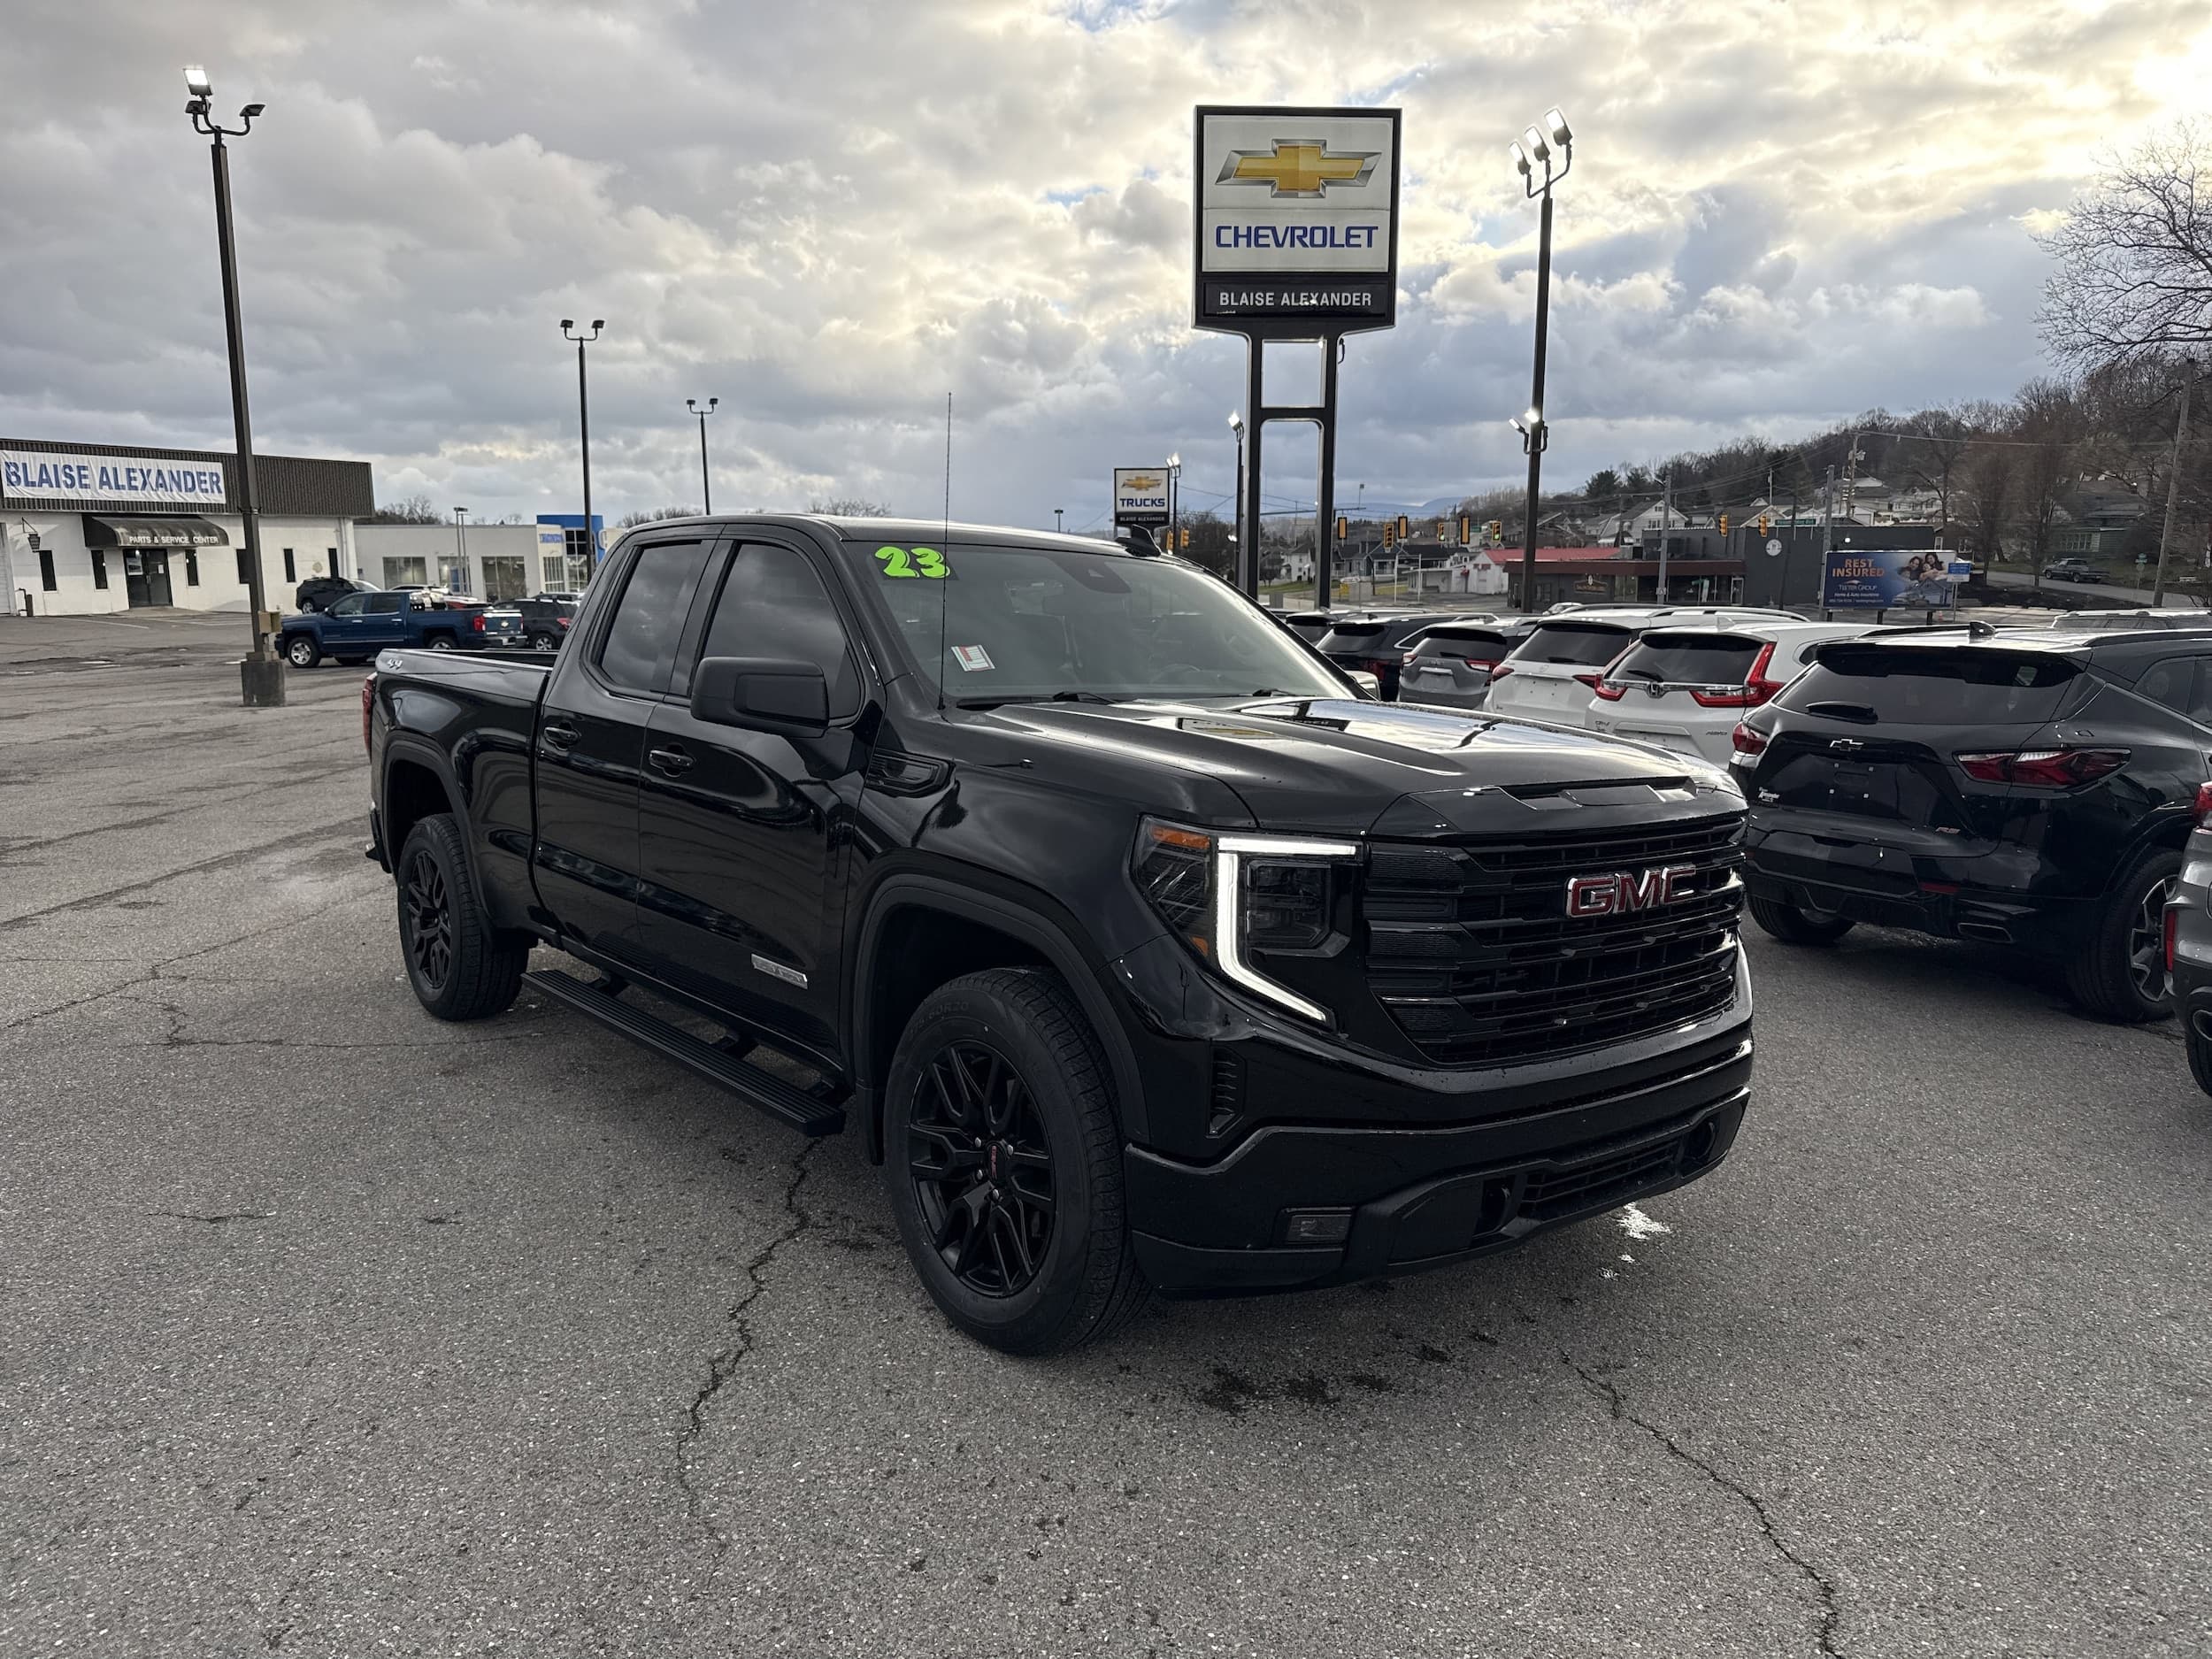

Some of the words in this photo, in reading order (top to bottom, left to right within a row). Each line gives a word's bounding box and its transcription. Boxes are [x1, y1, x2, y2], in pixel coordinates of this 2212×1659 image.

[1216, 226, 1379, 248] CHEVROLET
[1219, 292, 1275, 306] BLAISE
[1280, 292, 1371, 307] ALEXANDER
[4, 461, 91, 489] BLAISE
[98, 466, 223, 494] ALEXANDER
[1119, 498, 1165, 507] TRUCKS
[874, 546, 951, 579] 23
[1845, 558, 1874, 567] REST
[1832, 568, 1885, 577] INSURED
[1566, 864, 1697, 918] GMC
